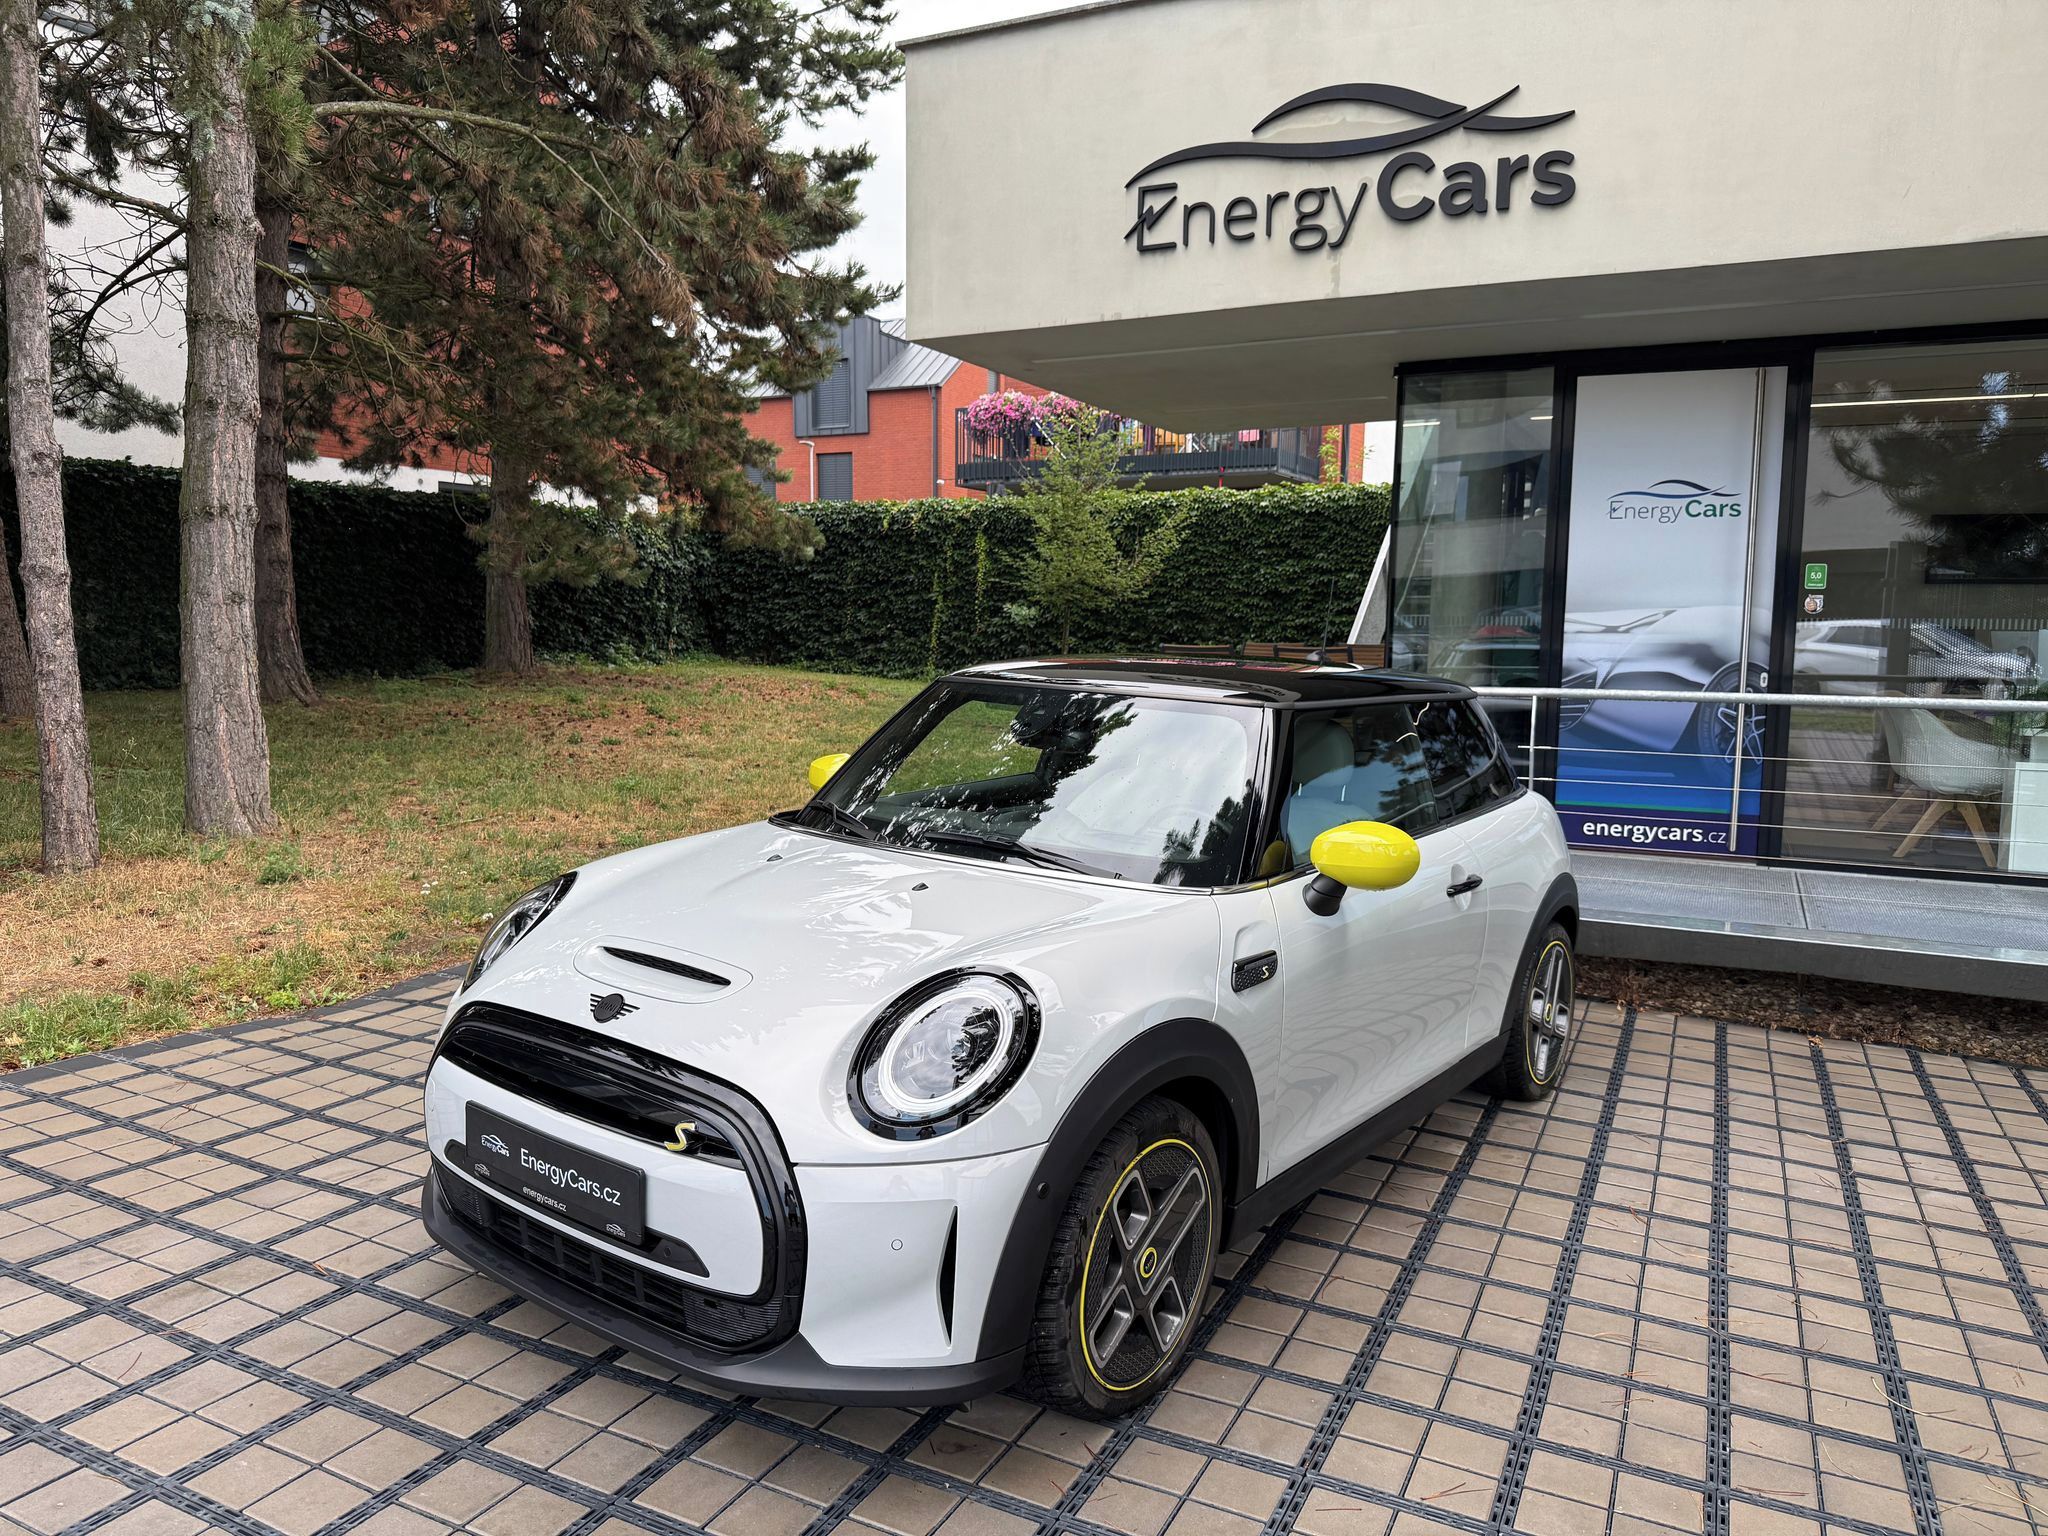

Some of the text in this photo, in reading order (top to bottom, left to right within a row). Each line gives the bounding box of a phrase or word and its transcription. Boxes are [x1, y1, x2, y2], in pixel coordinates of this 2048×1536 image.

[1582, 820, 1727, 844] energycars.cz
[664, 1120, 699, 1152] S
[520, 1147, 621, 1207] EnergyCars.cz
[522, 1185, 567, 1213] energycars.cz
